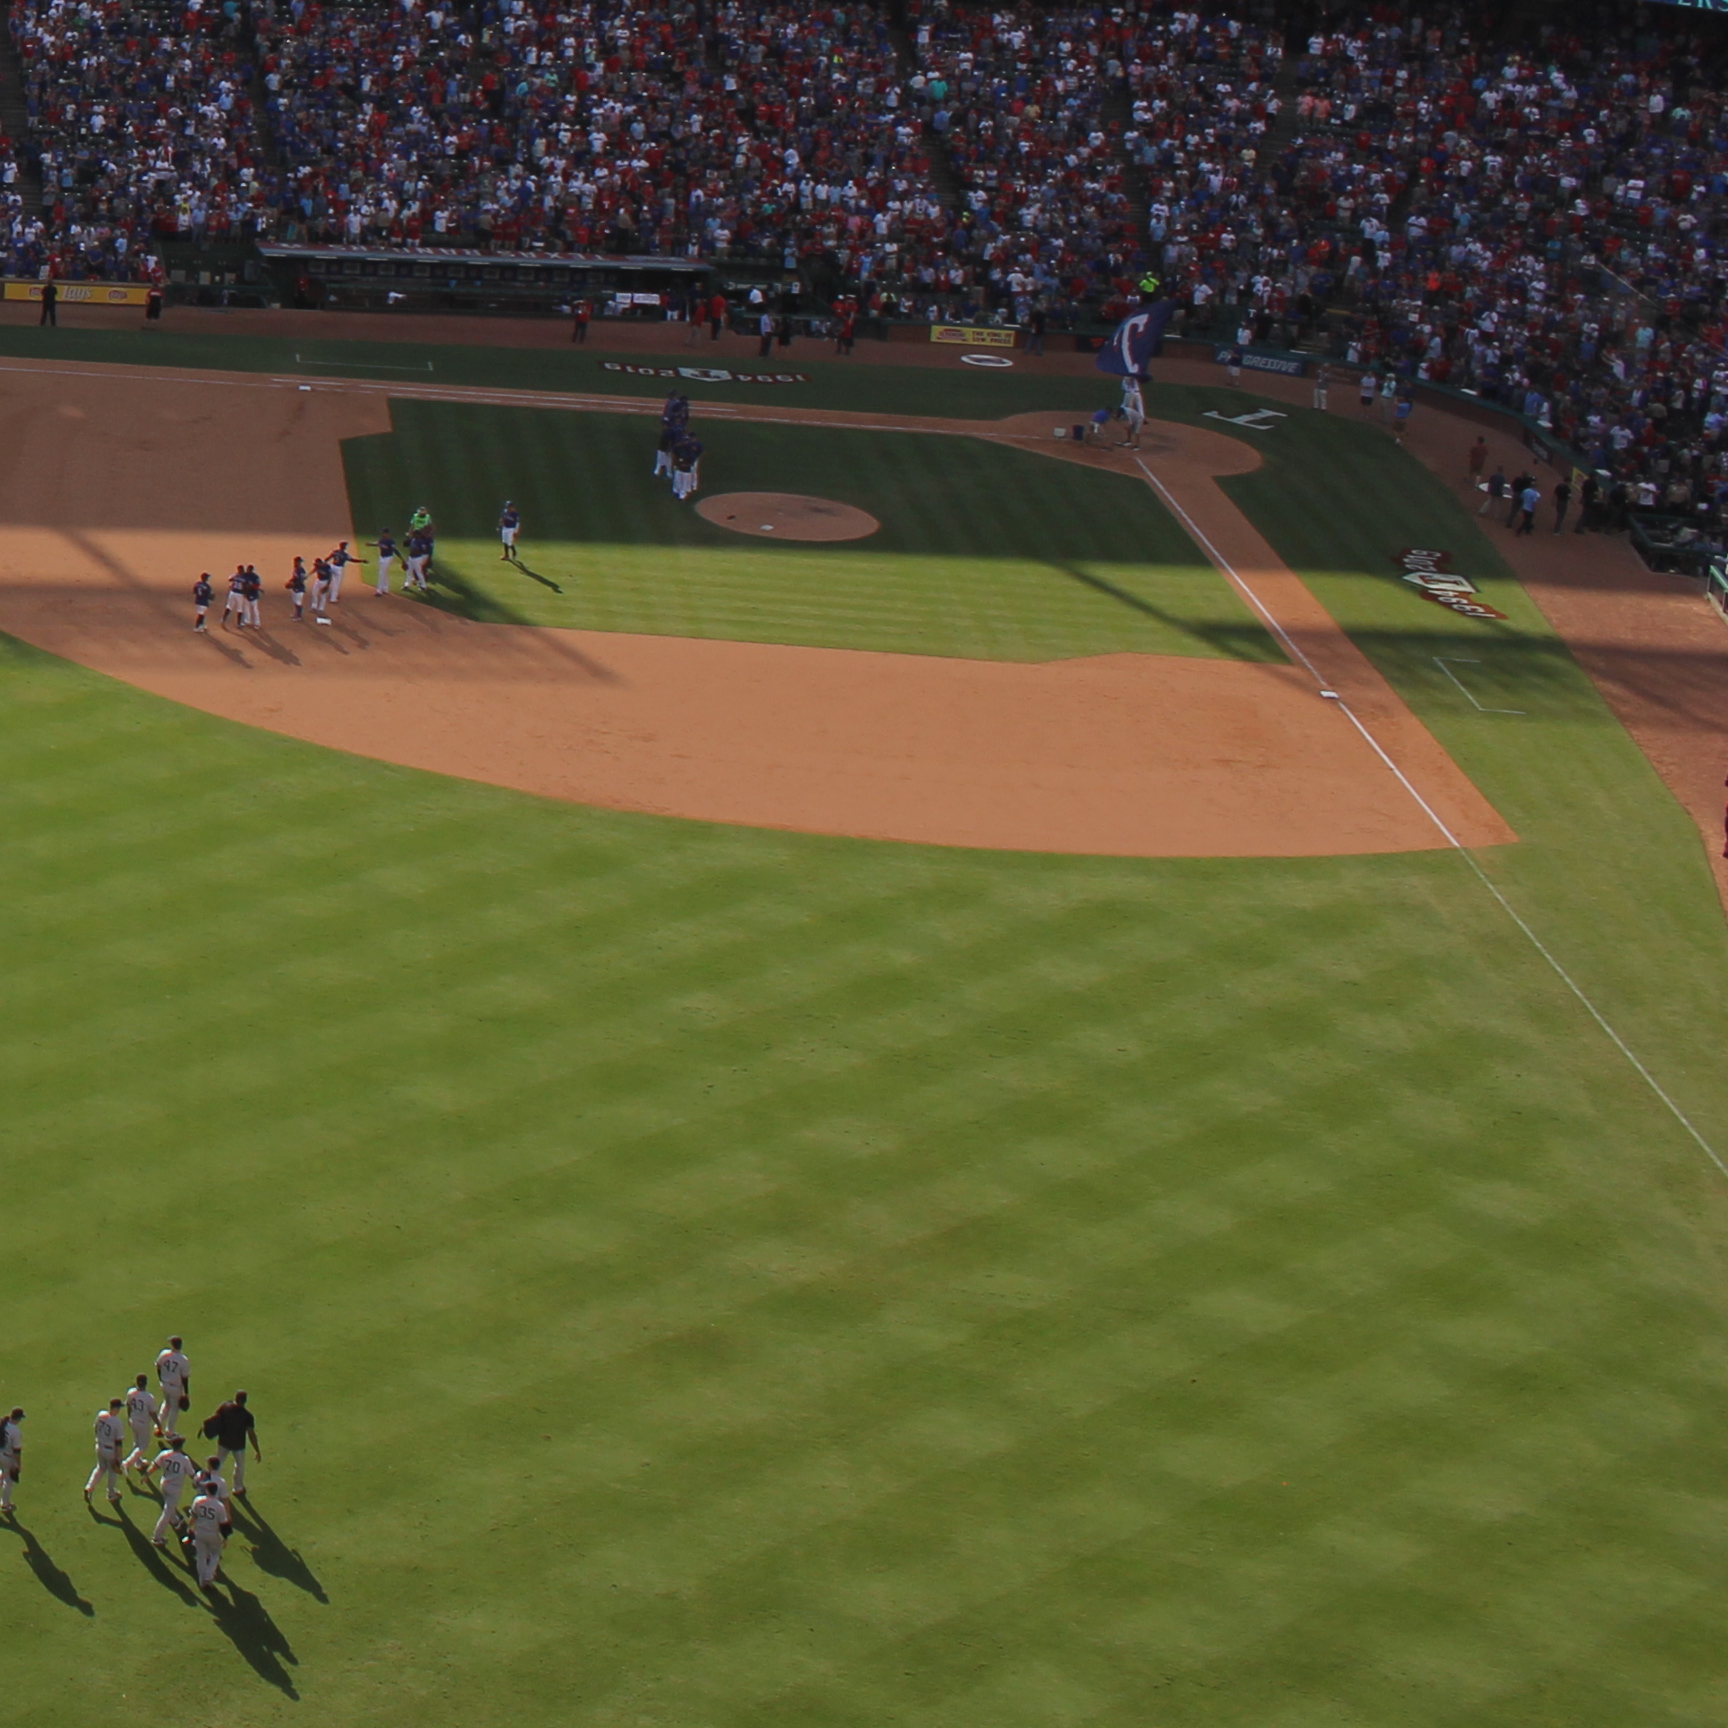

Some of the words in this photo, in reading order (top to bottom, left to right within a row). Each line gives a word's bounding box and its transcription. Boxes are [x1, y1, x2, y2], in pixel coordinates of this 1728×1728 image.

[1217, 350, 1300, 373] PGRESSIVE
[164, 1359, 179, 1373] 47
[99, 1420, 112, 1436] 73
[165, 1459, 181, 1472] 70
[199, 1505, 216, 1520] 35
